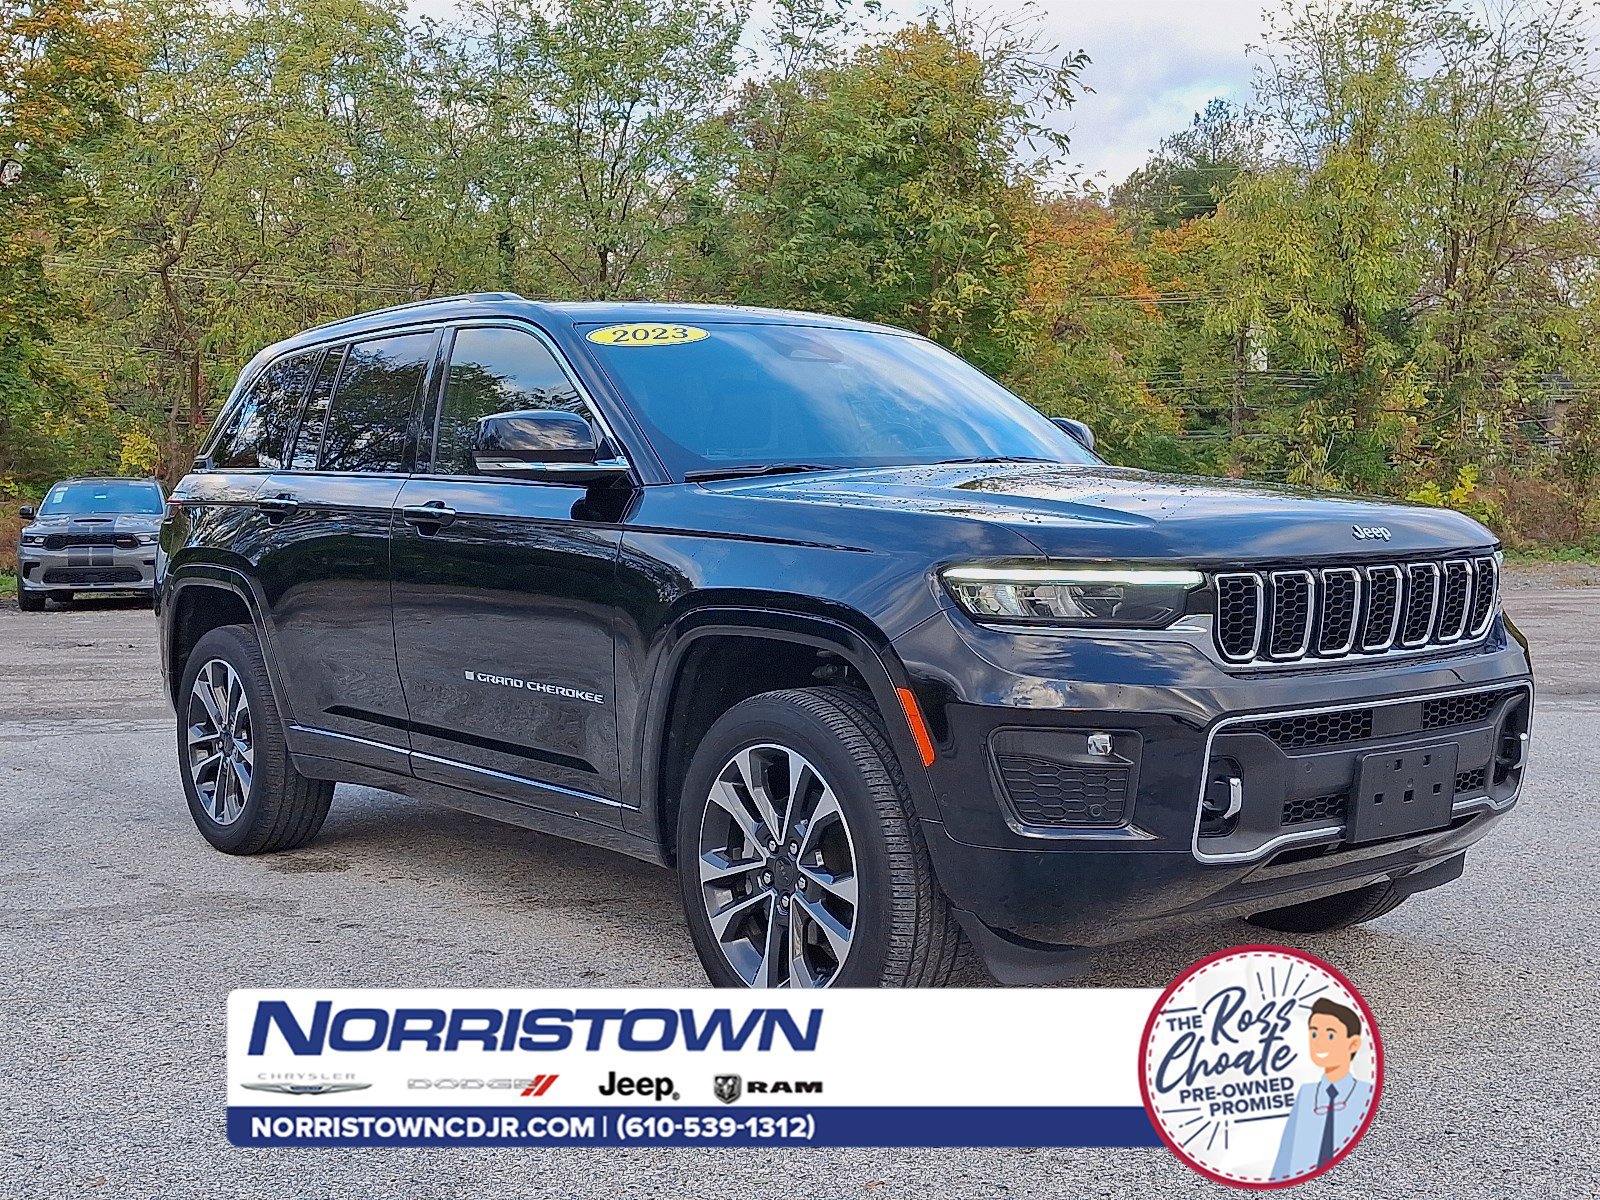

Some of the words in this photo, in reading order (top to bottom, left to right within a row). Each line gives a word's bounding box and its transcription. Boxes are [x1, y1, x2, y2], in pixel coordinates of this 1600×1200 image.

[612, 327, 689, 343] 2023
[1352, 524, 1392, 542] Jeep
[476, 672, 524, 689] GRAND
[526, 681, 605, 704] CHEROKEE
